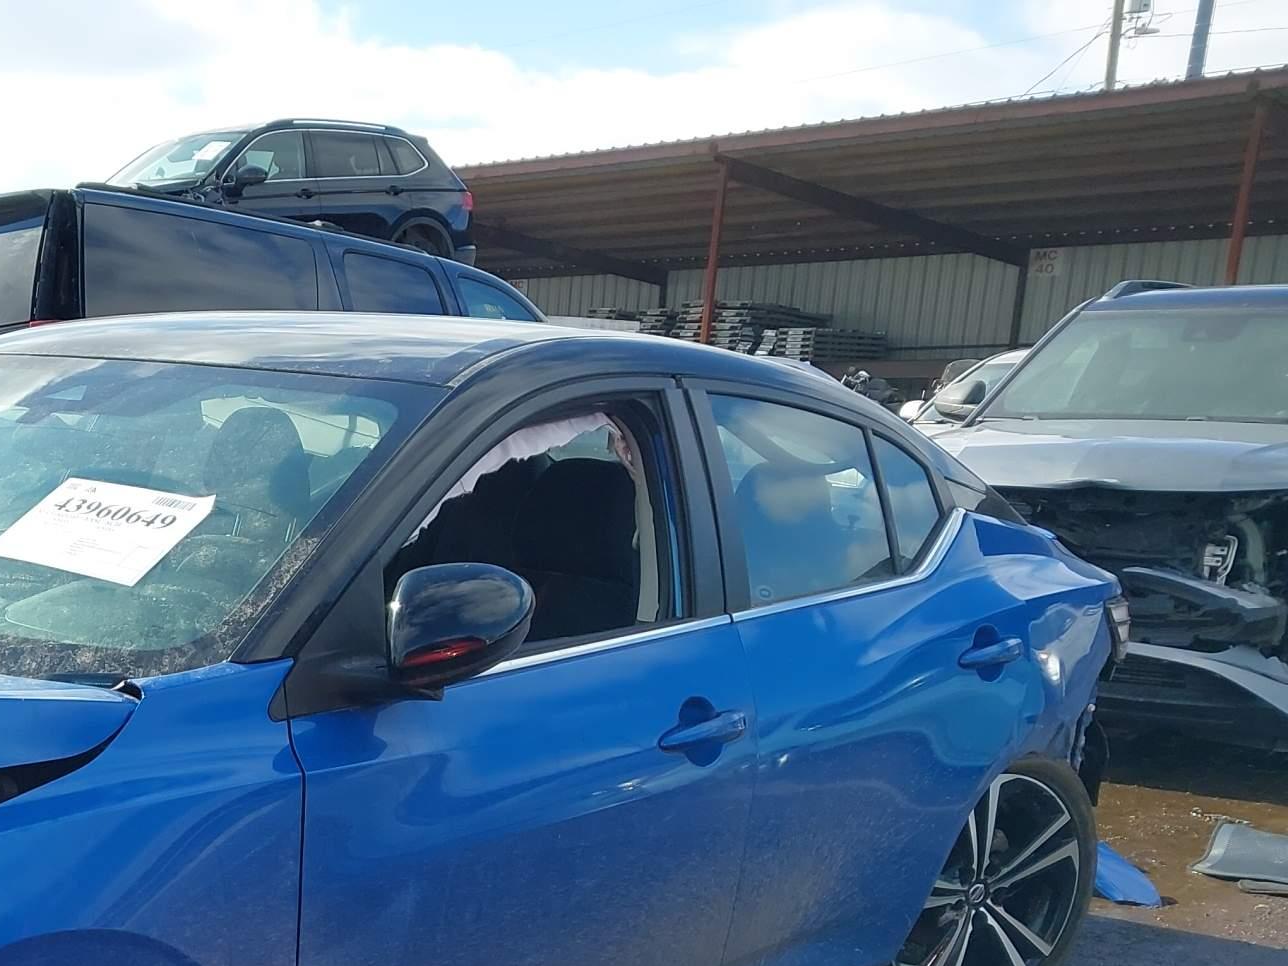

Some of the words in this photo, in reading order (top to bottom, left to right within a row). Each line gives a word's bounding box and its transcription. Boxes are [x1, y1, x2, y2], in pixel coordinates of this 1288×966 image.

[1035, 250, 1058, 261] MC
[1035, 264, 1054, 274] 40
[54, 497, 177, 529] 43960649
